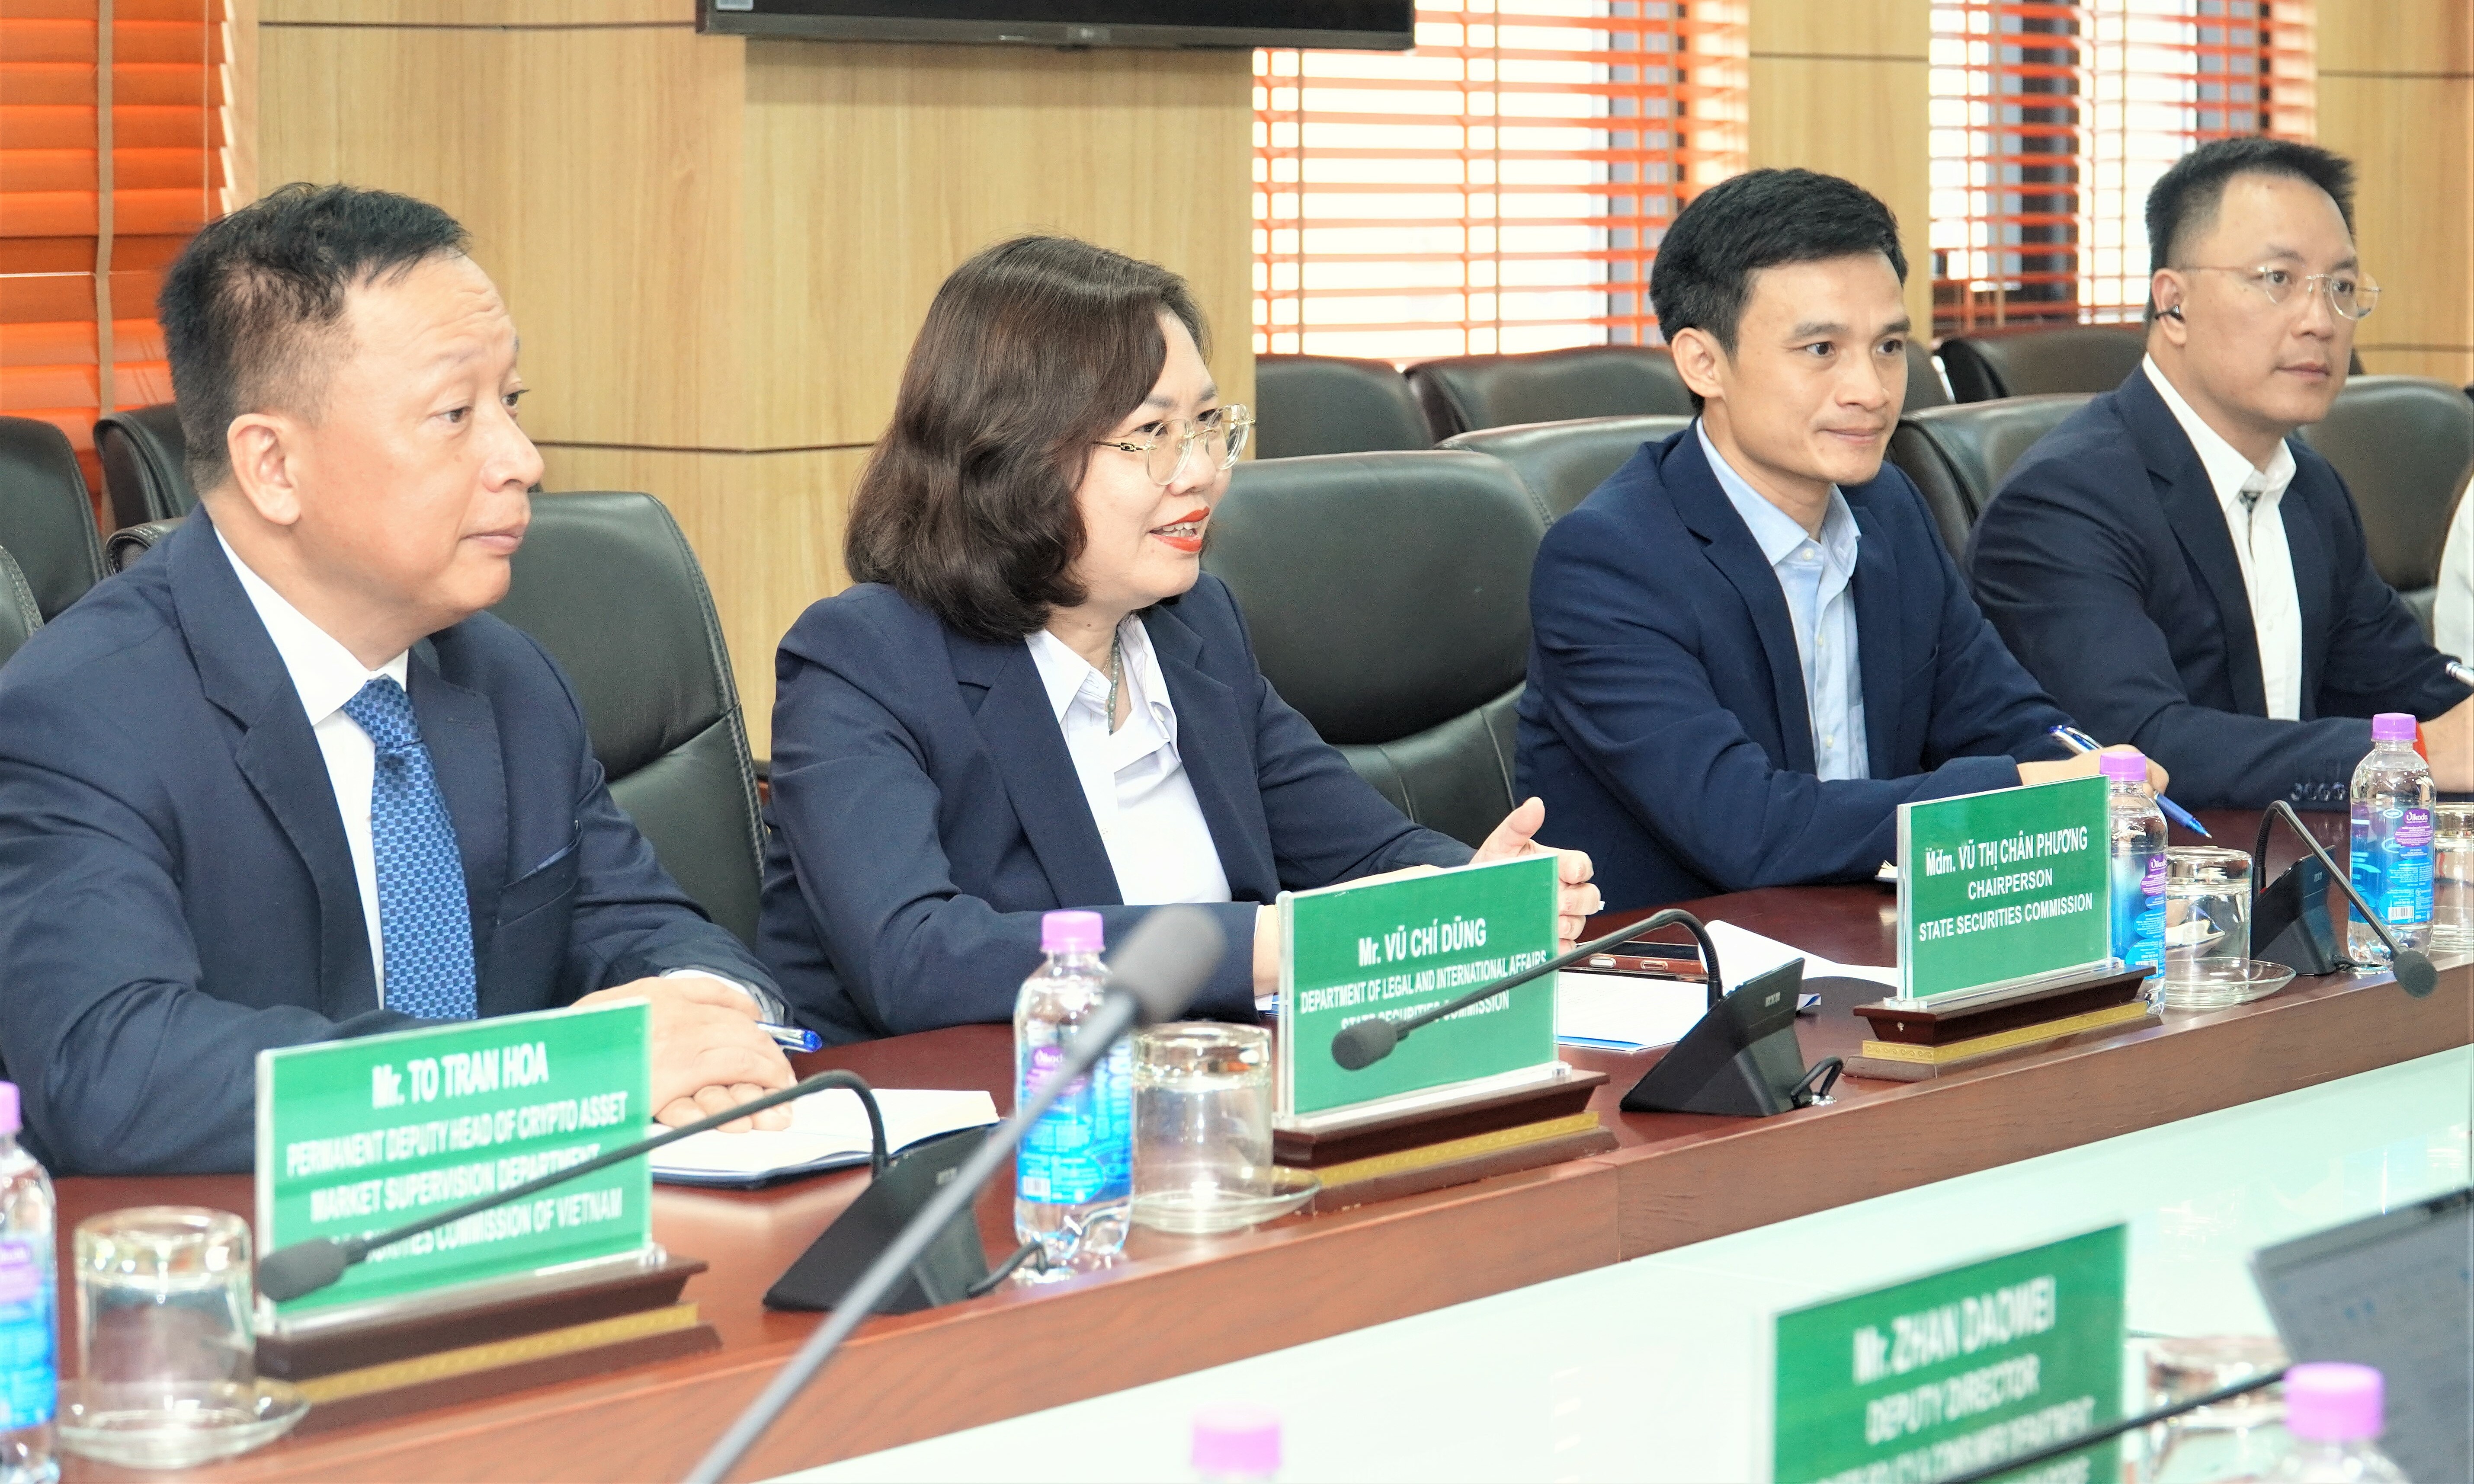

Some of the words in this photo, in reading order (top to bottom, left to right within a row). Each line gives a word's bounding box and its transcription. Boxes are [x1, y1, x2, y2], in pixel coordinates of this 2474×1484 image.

[1958, 838, 1975, 870] VŨ
[1978, 841, 1997, 871] THỊ
[2000, 830, 2034, 864] CHÂN
[2037, 826, 2088, 857] PHƯƠNG
[1968, 868, 2053, 900] CHAIRPERSON
[1358, 937, 1381, 967] Mr.
[1384, 924, 1407, 962] VŨ
[1410, 918, 1438, 958] CHÍ
[1441, 915, 1487, 953] DŨNG
[1919, 918, 1955, 942] STATE
[1956, 905, 2022, 935] SECURITIES
[2025, 892, 2093, 922] COMMISSION
[1300, 981, 1367, 1014] DEPARTMENT
[1367, 978, 1381, 1002] OF
[1382, 974, 1414, 1000] LEGAL
[1414, 969, 1436, 993] AND
[1436, 957, 1509, 989] INTERNATIONAL
[372, 1064, 405, 1110] Mr.
[407, 1057, 439, 1104] TO
[441, 1048, 500, 1099] TRAN
[502, 1041, 549, 1089] HOA
[286, 1129, 385, 1178] PERMANENT
[385, 1119, 449, 1161] DEPUTY
[449, 1113, 493, 1151] HEAD
[494, 1108, 517, 1144] OF
[517, 1099, 578, 1140] CRYPTO
[578, 1090, 628, 1129] ASSET
[310, 1179, 383, 1223] MARKET
[384, 1161, 496, 1211] SUPERVISION
[532, 1198, 554, 1233] OF
[555, 1187, 623, 1229] VIETNAM
